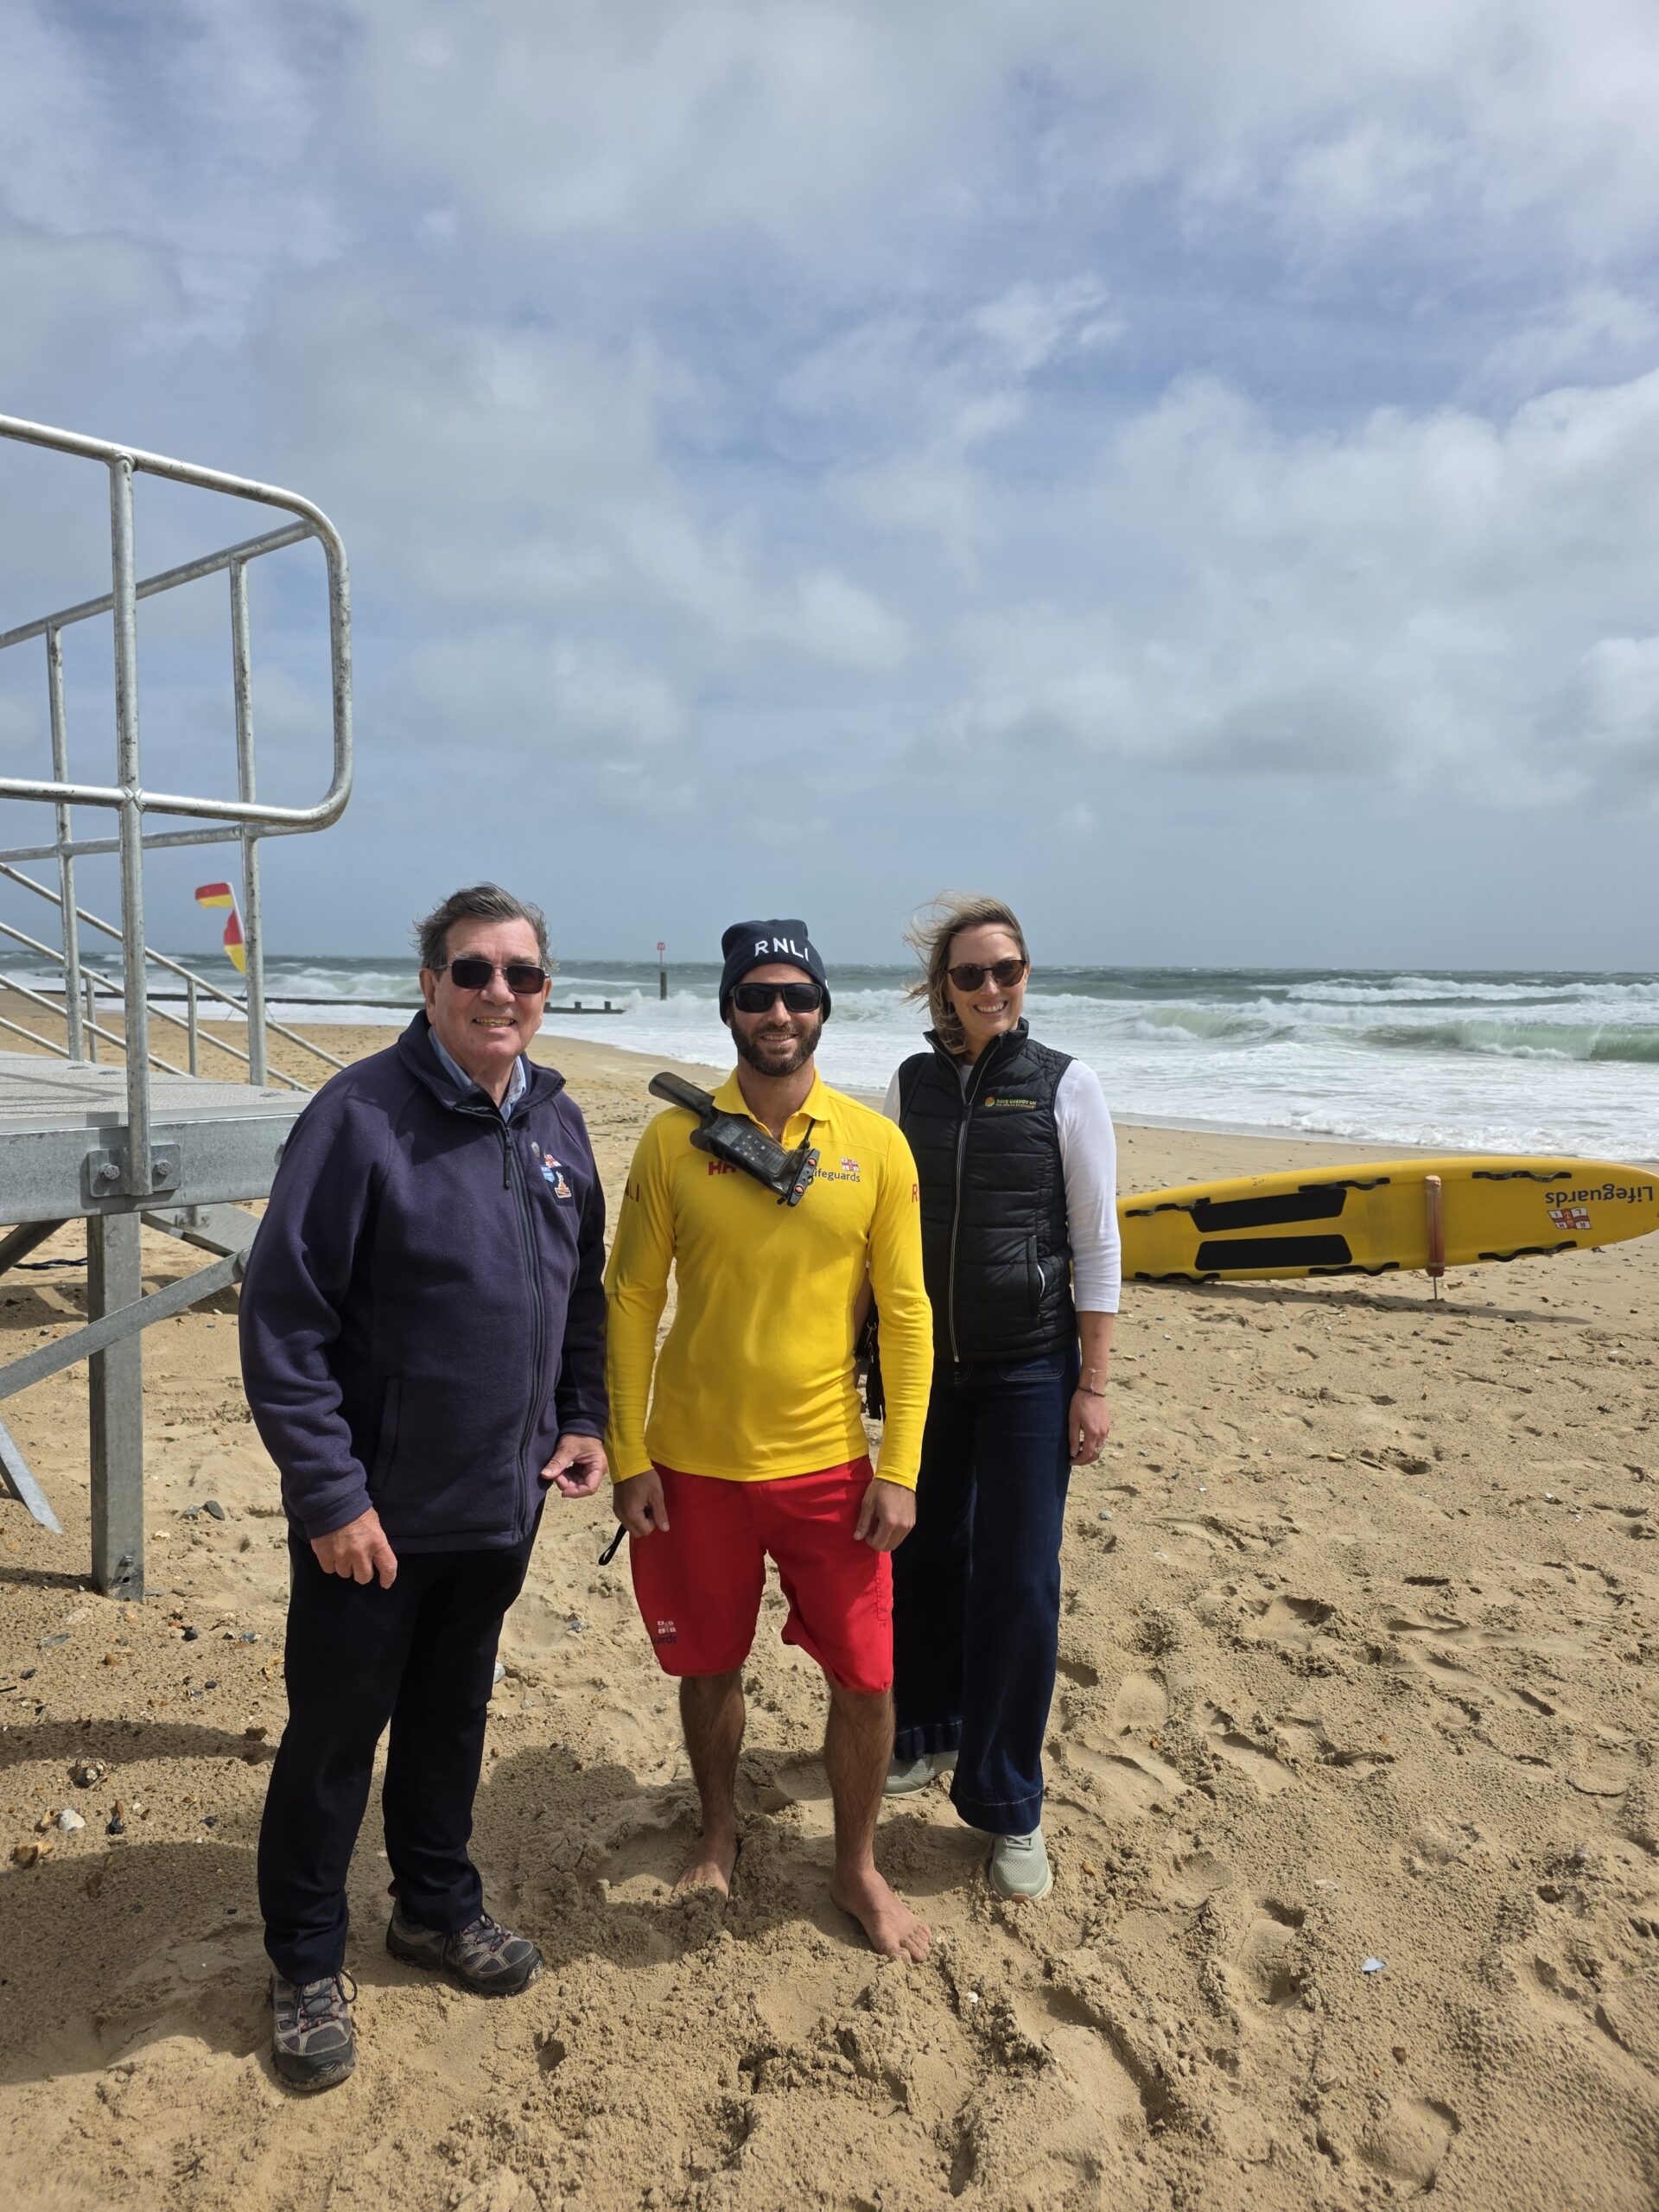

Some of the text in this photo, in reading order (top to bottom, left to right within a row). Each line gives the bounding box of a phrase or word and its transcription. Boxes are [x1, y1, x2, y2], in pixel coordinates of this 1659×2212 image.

[754, 938, 809, 962] RNLI
[813, 1167, 861, 1183] ifeguards
[1545, 1184, 1653, 1207] Lifeguards
